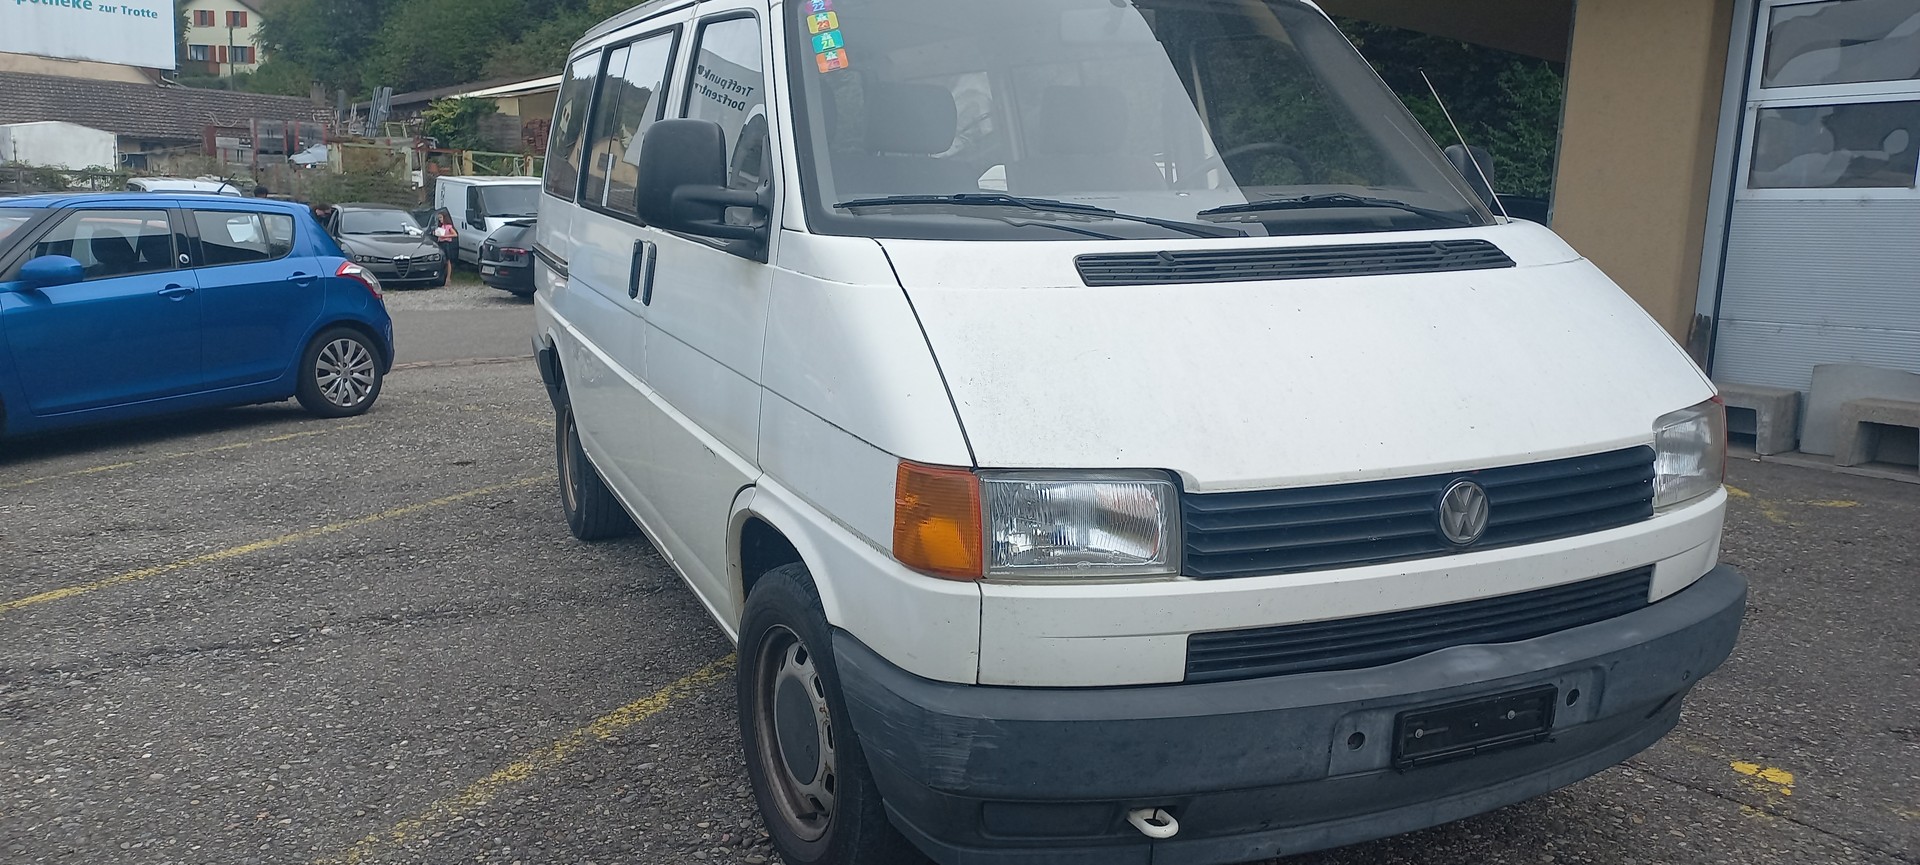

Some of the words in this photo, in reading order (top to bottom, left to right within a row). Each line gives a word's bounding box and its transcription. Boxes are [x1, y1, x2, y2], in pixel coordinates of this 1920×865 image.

[98, 4, 117, 13] zur
[120, 5, 158, 19] Trotte
[812, 2, 825, 12] 22
[817, 20, 831, 31] 23
